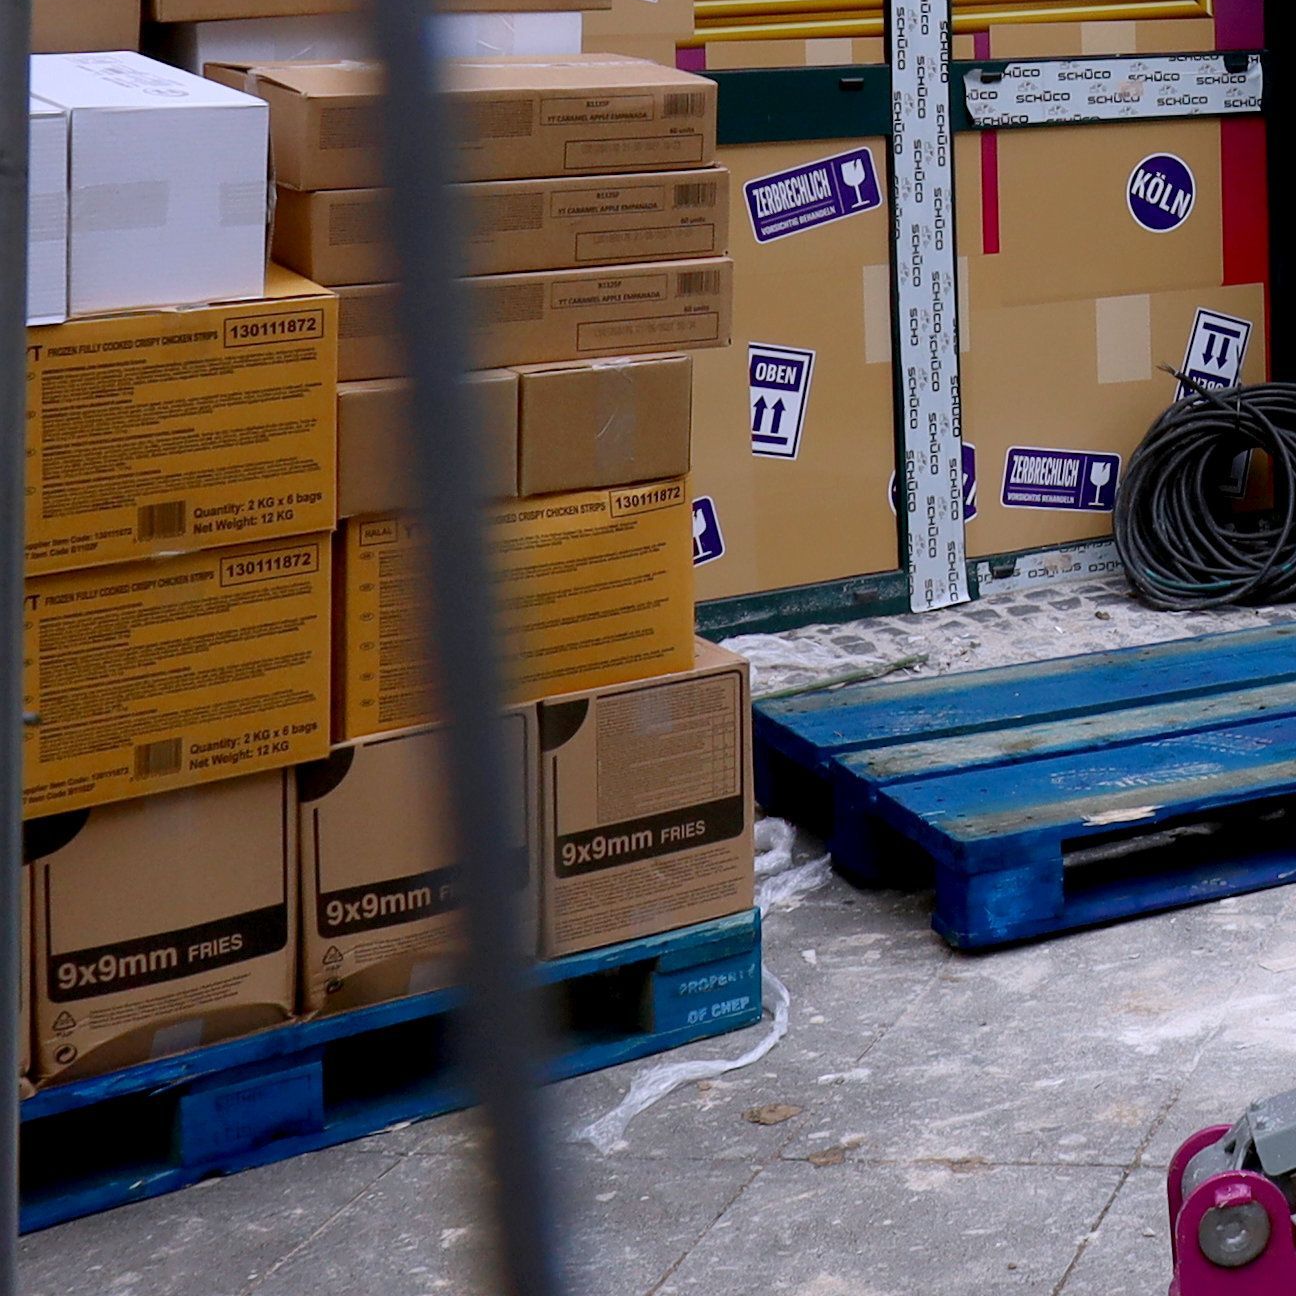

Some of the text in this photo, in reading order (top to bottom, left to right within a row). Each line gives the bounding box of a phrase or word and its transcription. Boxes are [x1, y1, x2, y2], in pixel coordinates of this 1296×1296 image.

[752, 168, 832, 218] ZERBRECHLICH
[1131, 169, 1192, 219] KÖLN
[761, 206, 836, 236] VORSICHTIG BEHANDELN
[230, 317, 316, 339] 130111872
[47, 330, 218, 358] FROZEN FULLY COOKED CRISPY CHICKEN STRIPS
[755, 363, 797, 385] OBEN
[1010, 455, 1080, 488] ZERBRECHLICH
[193, 503, 243, 519] Quantity:
[248, 500, 255, 511] 2
[259, 498, 275, 509] KG
[287, 494, 294, 504] 6
[296, 491, 322, 504] bags
[615, 486, 681, 509] 130111872
[1007, 493, 1075, 504] VORSICHTIG BEHANDELN
[193, 509, 293, 535] Net Weight: 12 KG
[519, 502, 606, 522] CRISPY CHICKEN STRIPS
[365, 527, 392, 537] HALAL
[226, 553, 311, 578] 130111872
[45, 571, 214, 606] FROZEN FULLY COOKED CRISPY CHICKEN STRIPS
[190, 723, 318, 755] Quantity: 2 KG bags
[189, 742, 289, 770] Net Weight: 12 KG
[562, 820, 706, 866] 9x9mm FRIES
[326, 887, 431, 925] 9x9mm
[57, 934, 242, 991] 9x9mm FRIES
[687, 996, 749, 1024] OF CHEP
